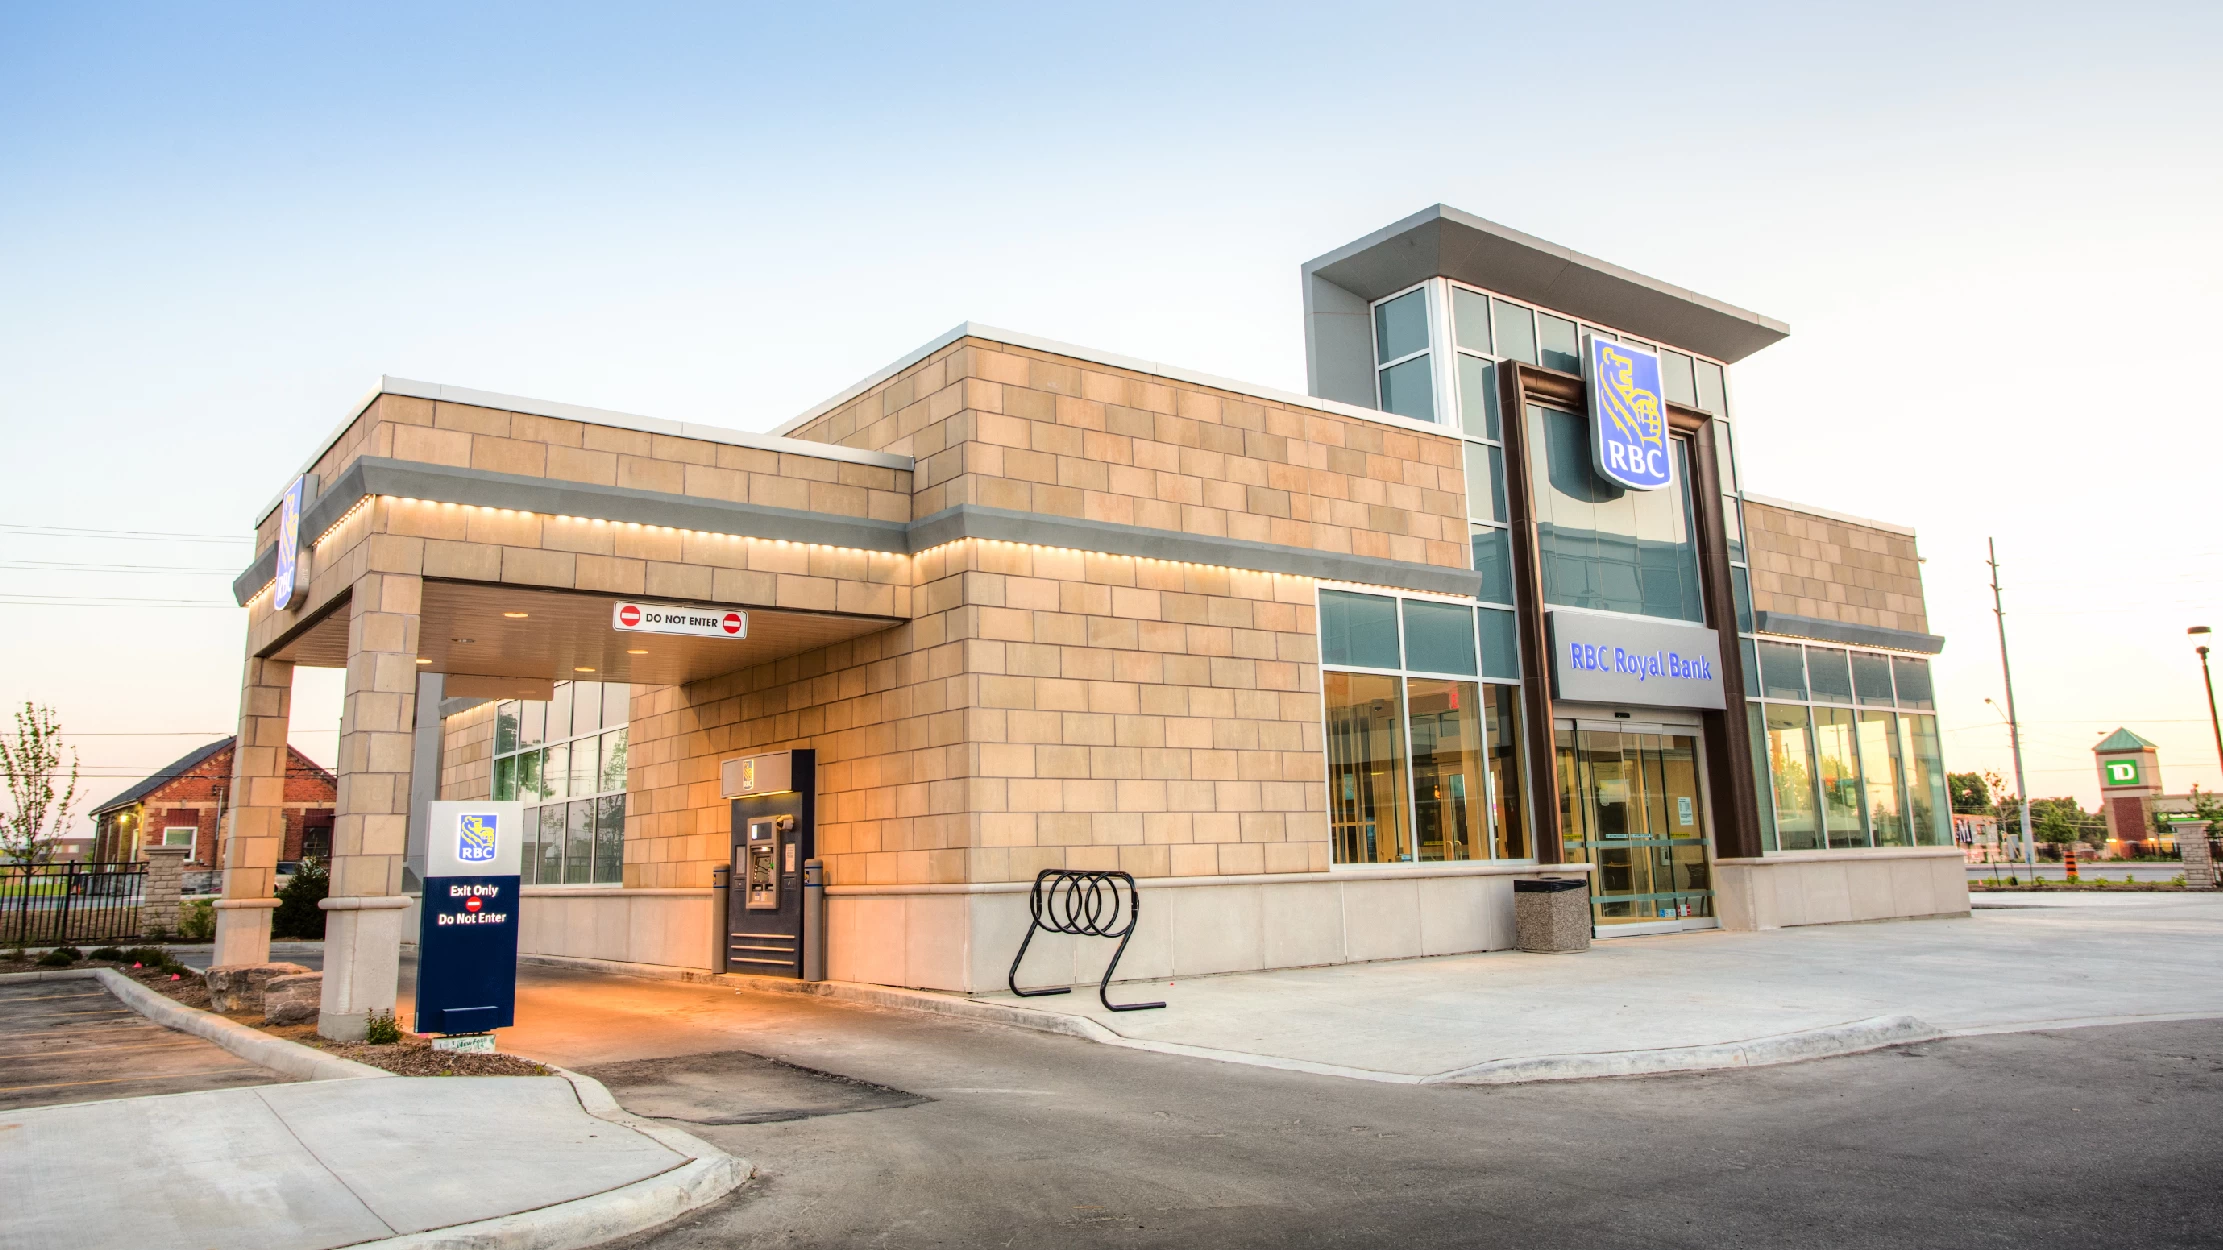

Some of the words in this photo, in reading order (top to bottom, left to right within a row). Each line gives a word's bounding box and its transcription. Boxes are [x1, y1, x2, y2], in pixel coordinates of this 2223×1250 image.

[1608, 440, 1665, 478] RBC
[646, 613, 662, 624] DO
[665, 614, 686, 625] NOT
[689, 616, 719, 628] ENTER
[1569, 642, 1610, 672] RBC
[1613, 647, 1665, 682] Royal
[1668, 651, 1712, 680] Bank
[2107, 763, 2135, 781] TD
[462, 847, 493, 859] RBC
[450, 884, 472, 897] Exit
[473, 883, 499, 897] Only
[438, 913, 454, 925] Do
[456, 912, 476, 924] Not
[478, 912, 507, 923] Enter
